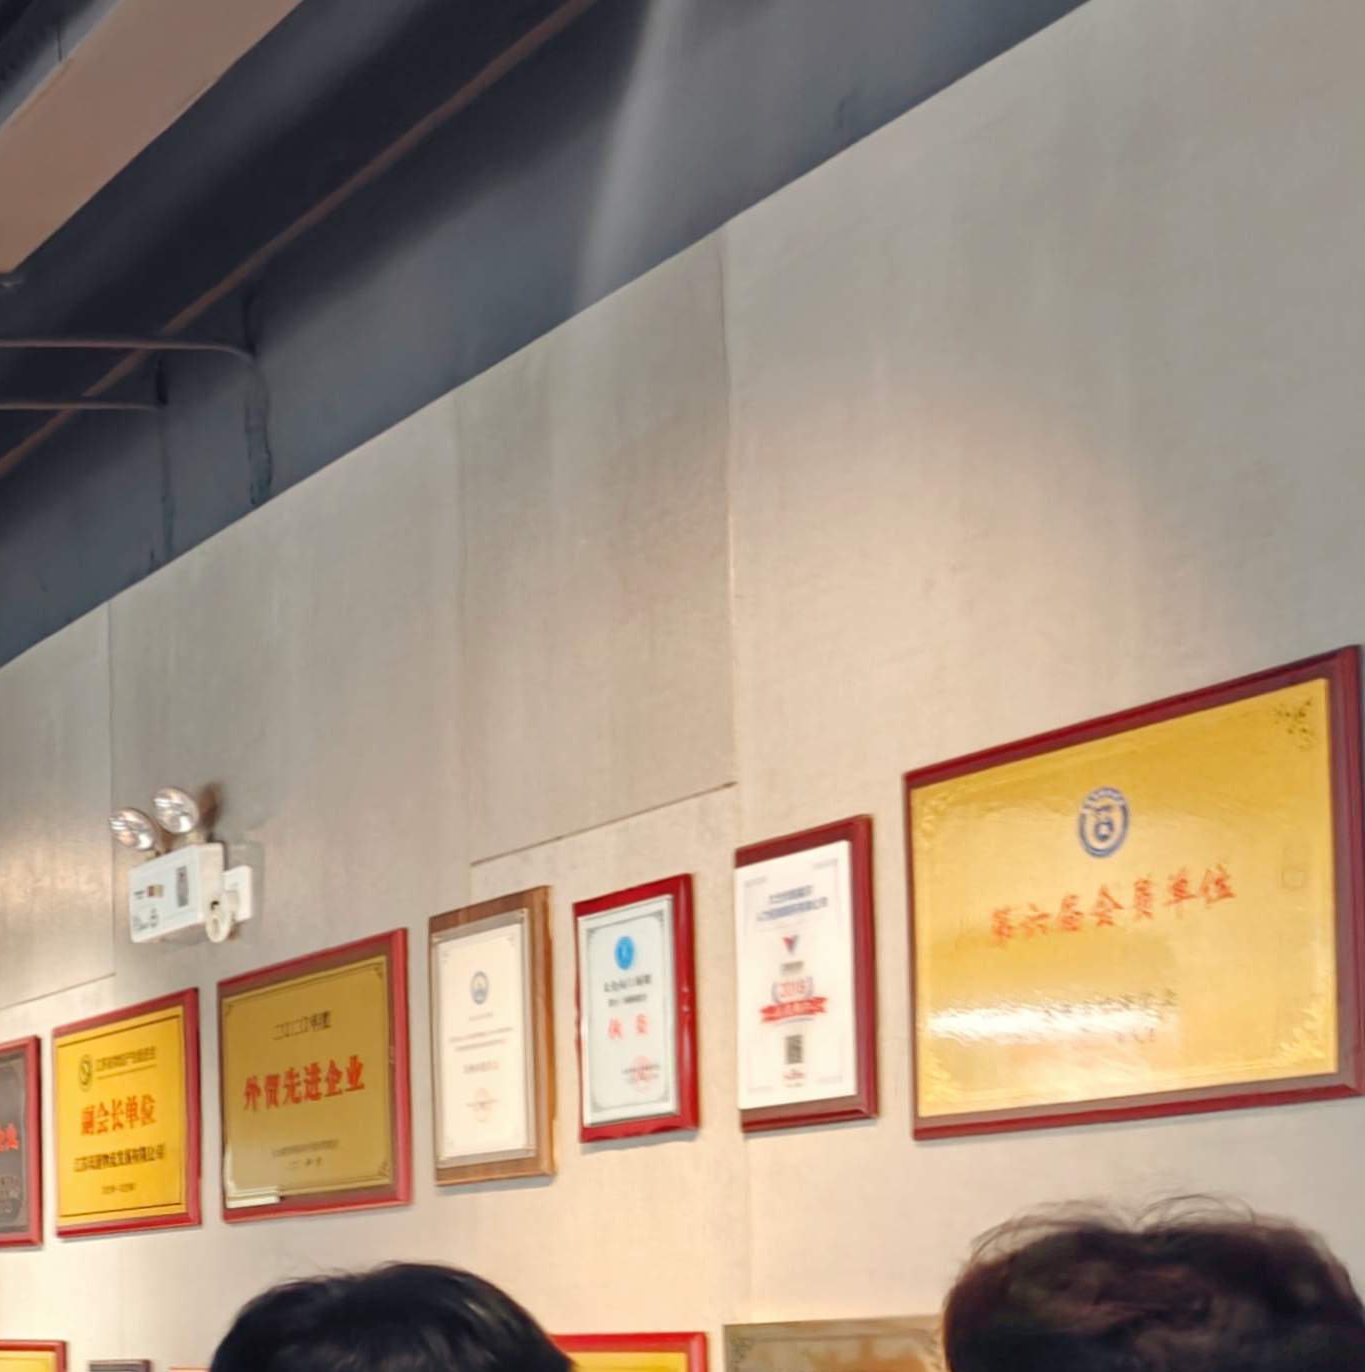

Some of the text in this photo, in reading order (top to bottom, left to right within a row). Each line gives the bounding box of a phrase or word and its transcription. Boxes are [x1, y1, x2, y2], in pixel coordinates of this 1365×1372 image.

[244, 1055, 366, 1112] 外贸先进企业
[81, 1093, 157, 1137] 副会长单位
